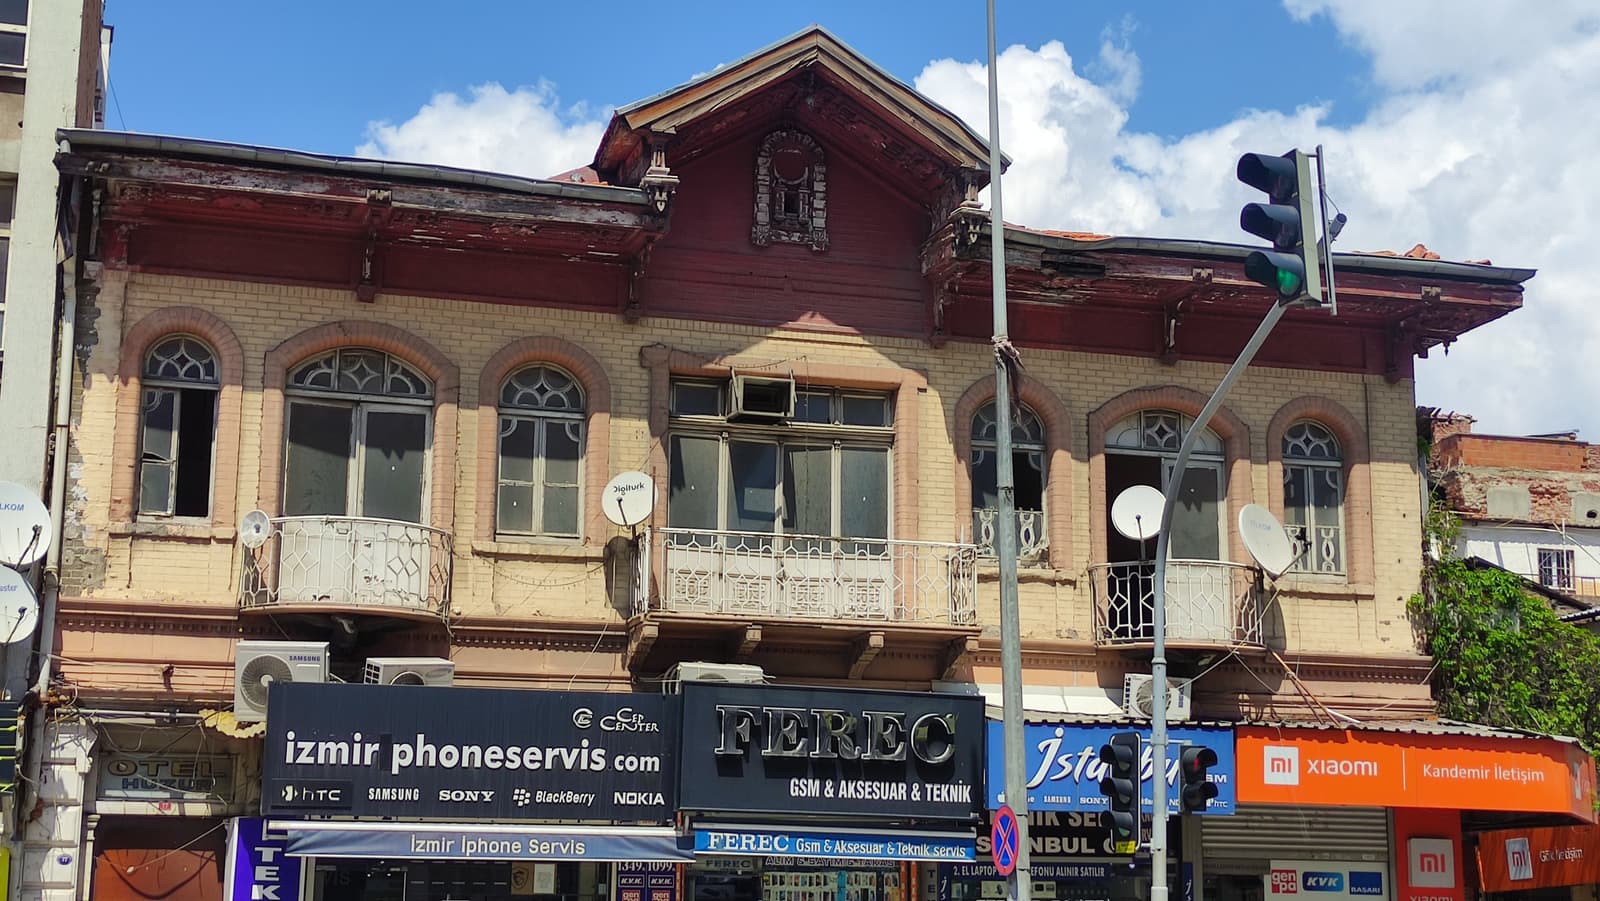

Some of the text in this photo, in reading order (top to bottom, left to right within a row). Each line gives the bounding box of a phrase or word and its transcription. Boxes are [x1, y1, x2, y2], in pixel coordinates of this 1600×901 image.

[714, 704, 959, 764] FEREC
[285, 730, 380, 765] izmir
[107, 760, 226, 778] OTEL
[1423, 763, 1545, 785] Kandemir İletişim
[368, 787, 420, 801] SAMSUNG
[438, 789, 495, 803] SONY
[790, 777, 973, 803] GSM & AKSESUAR & TEKNİK
[535, 790, 596, 807] BlackBerry
[613, 791, 666, 806] NOKIA
[1079, 796, 1109, 805] SONY
[528, 838, 586, 855] Servis
[706, 831, 790, 852] FEREC
[795, 838, 821, 853] Gsm
[823, 839, 833, 853] &
[834, 840, 885, 855] Aksesuar
[887, 841, 896, 855] &
[933, 845, 967, 858] servis
[962, 866, 970, 876] EL
[1272, 872, 1296, 882] gen
[1280, 882, 1297, 891] pa
[1307, 876, 1339, 887] KVK
